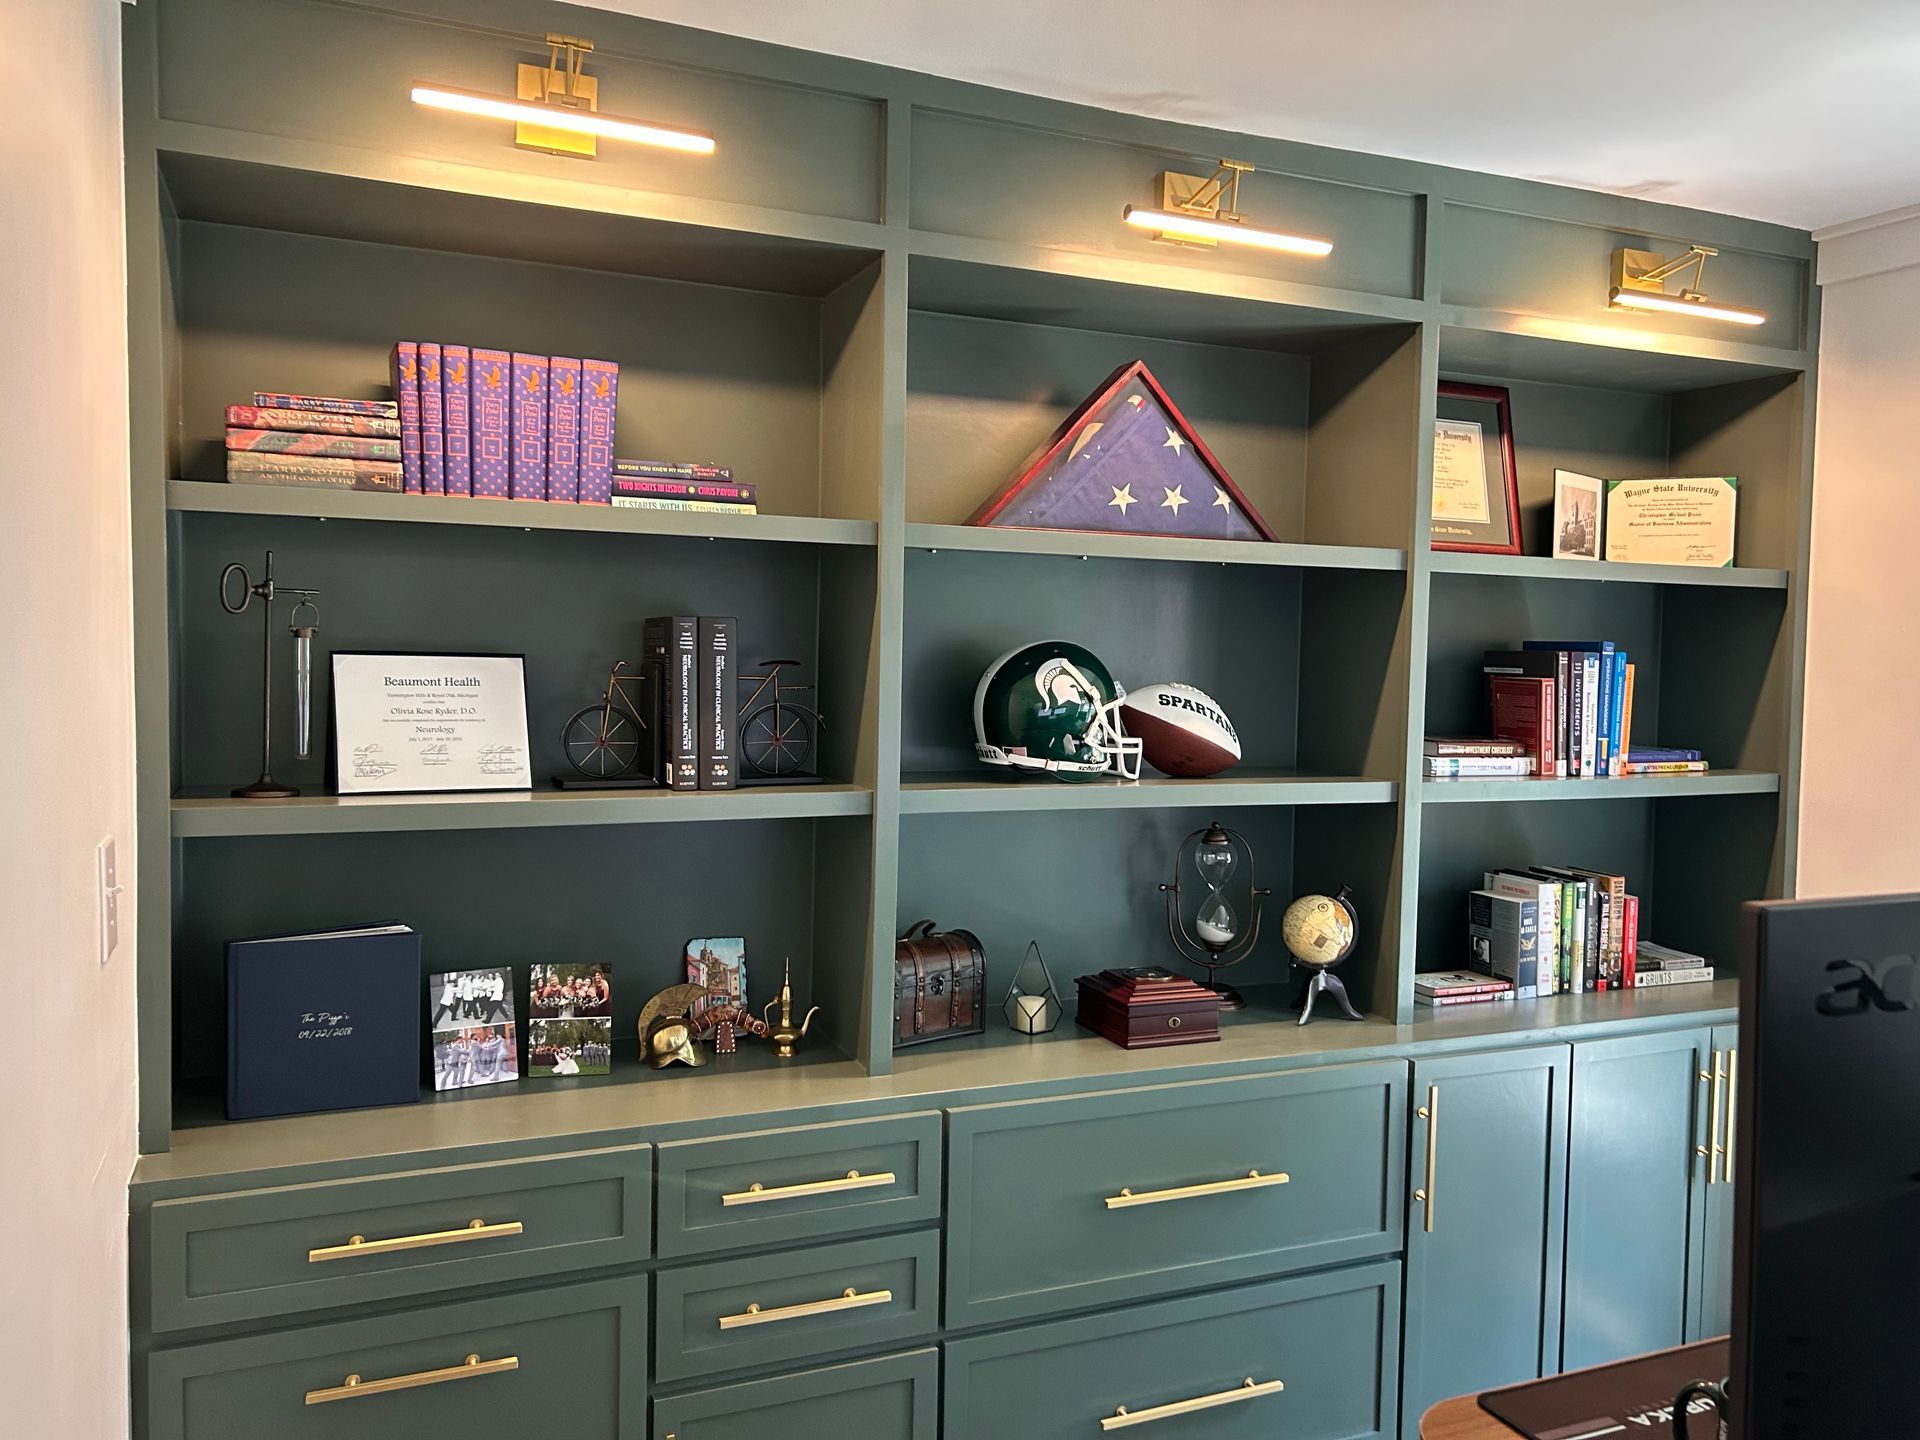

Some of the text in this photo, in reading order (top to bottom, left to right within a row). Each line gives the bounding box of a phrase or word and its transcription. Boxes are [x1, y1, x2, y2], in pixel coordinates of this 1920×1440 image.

[260, 464, 356, 477] HARRY POTTER
[618, 481, 686, 493] TWO NIGHTS IN LISBON
[698, 486, 716, 495] CHRIS
[1624, 488, 1650, 498] Wayne
[1678, 484, 1719, 496] University
[629, 501, 657, 509] STARTS
[660, 502, 680, 510] WITH
[682, 503, 692, 512] US
[384, 677, 480, 686] Beaumont Health
[1158, 694, 1237, 743] SPARTANS
[416, 726, 455, 734] Neurology
[1466, 746, 1490, 754] INVESTMENT
[1491, 746, 1513, 754] CHECKLIST
[1614, 880, 1623, 919] DAN BROWN
[1646, 972, 1672, 985] GRUNTS
[1816, 953, 1920, 1017] ac
[300, 1013, 315, 1023] The
[298, 1027, 353, 1039] 09/22/2018
